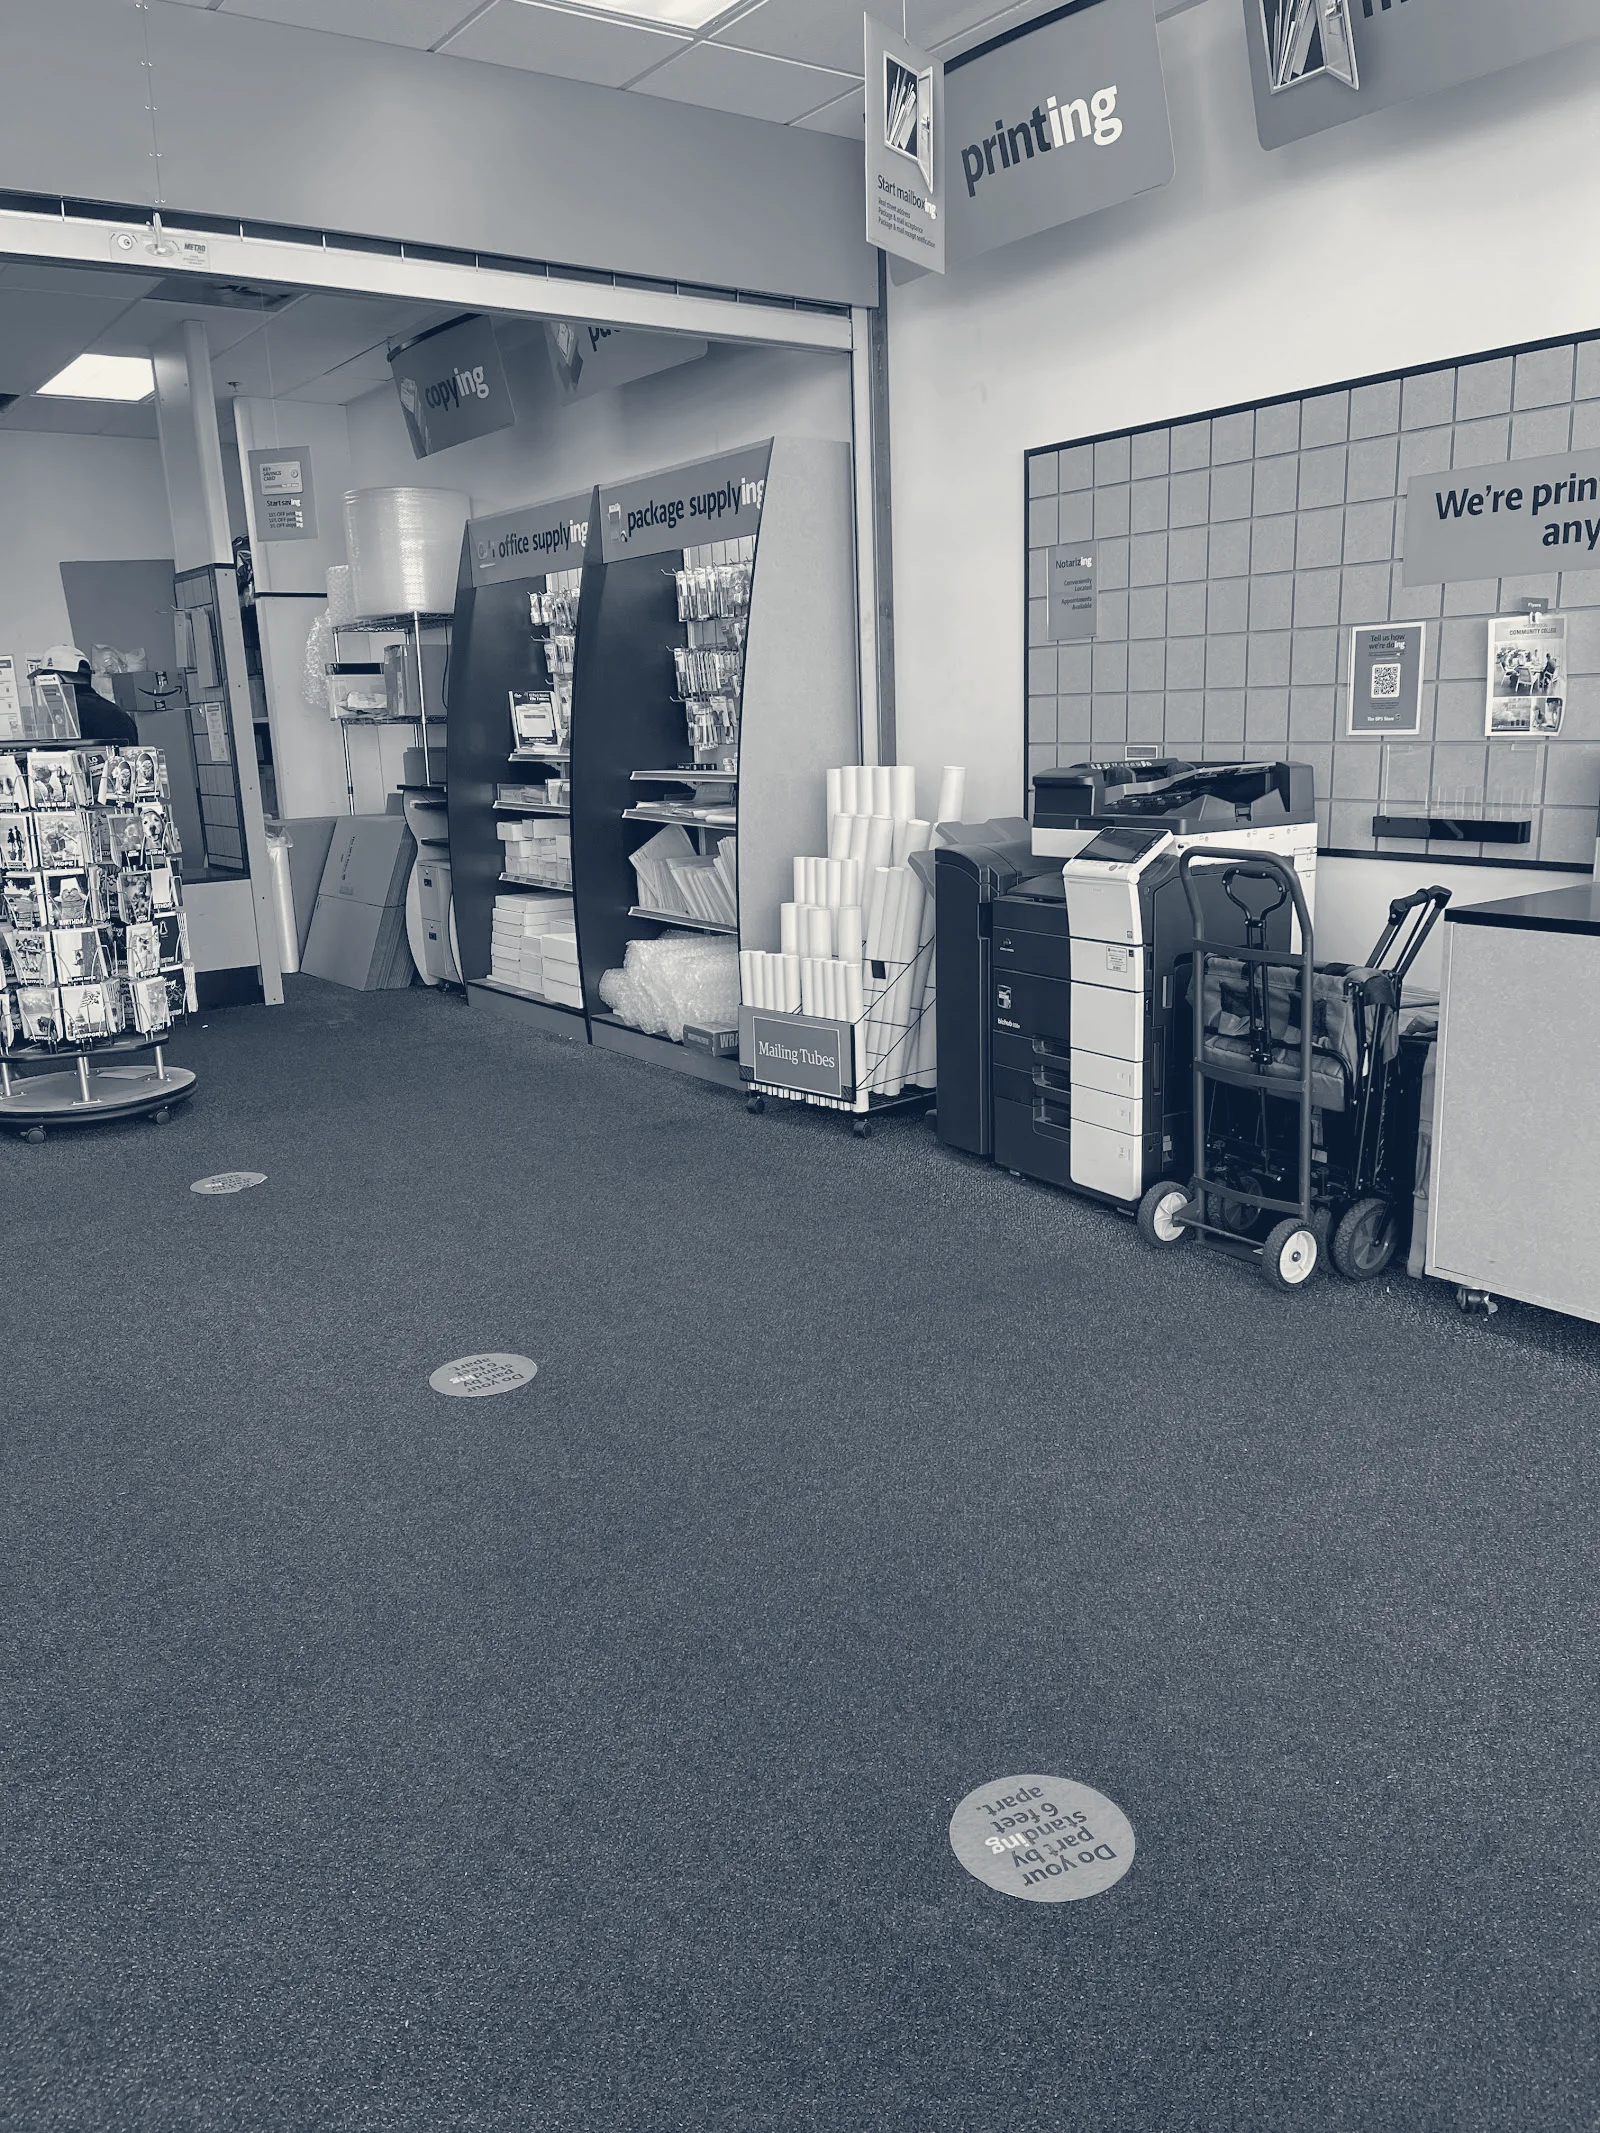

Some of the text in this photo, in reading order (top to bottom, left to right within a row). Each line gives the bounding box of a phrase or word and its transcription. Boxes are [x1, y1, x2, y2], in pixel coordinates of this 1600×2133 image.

[961, 84, 1123, 198] printing
[877, 174, 896, 197] Start
[184, 242, 206, 252] METRO
[425, 365, 490, 412] copying
[627, 477, 765, 537] package supplying
[1435, 473, 1600, 520] We’re prin
[499, 519, 589, 558] office supplying
[1056, 556, 1093, 569] Notarizing
[1063, 578, 1093, 587] Conveniently
[1074, 584, 1093, 592] Located
[1061, 596, 1092, 605] Appointments
[1072, 602, 1093, 610] Available
[1370, 634, 1382, 642] Tell
[1390, 633, 1406, 641] how
[1509, 627, 1540, 636] COMMUNITY
[758, 1040, 835, 1068] Mailing Tubes
[449, 1363, 513, 1384] standing
[456, 1365, 485, 1377] feet
[463, 1368, 515, 1387] part by
[467, 1373, 525, 1393] Do your
[975, 1786, 1044, 1816] apart.
[990, 1802, 1059, 1834] 6 feet
[984, 1810, 1088, 1855] standing
[1011, 1826, 1095, 1868] part by
[1021, 1843, 1118, 1887] Do your
